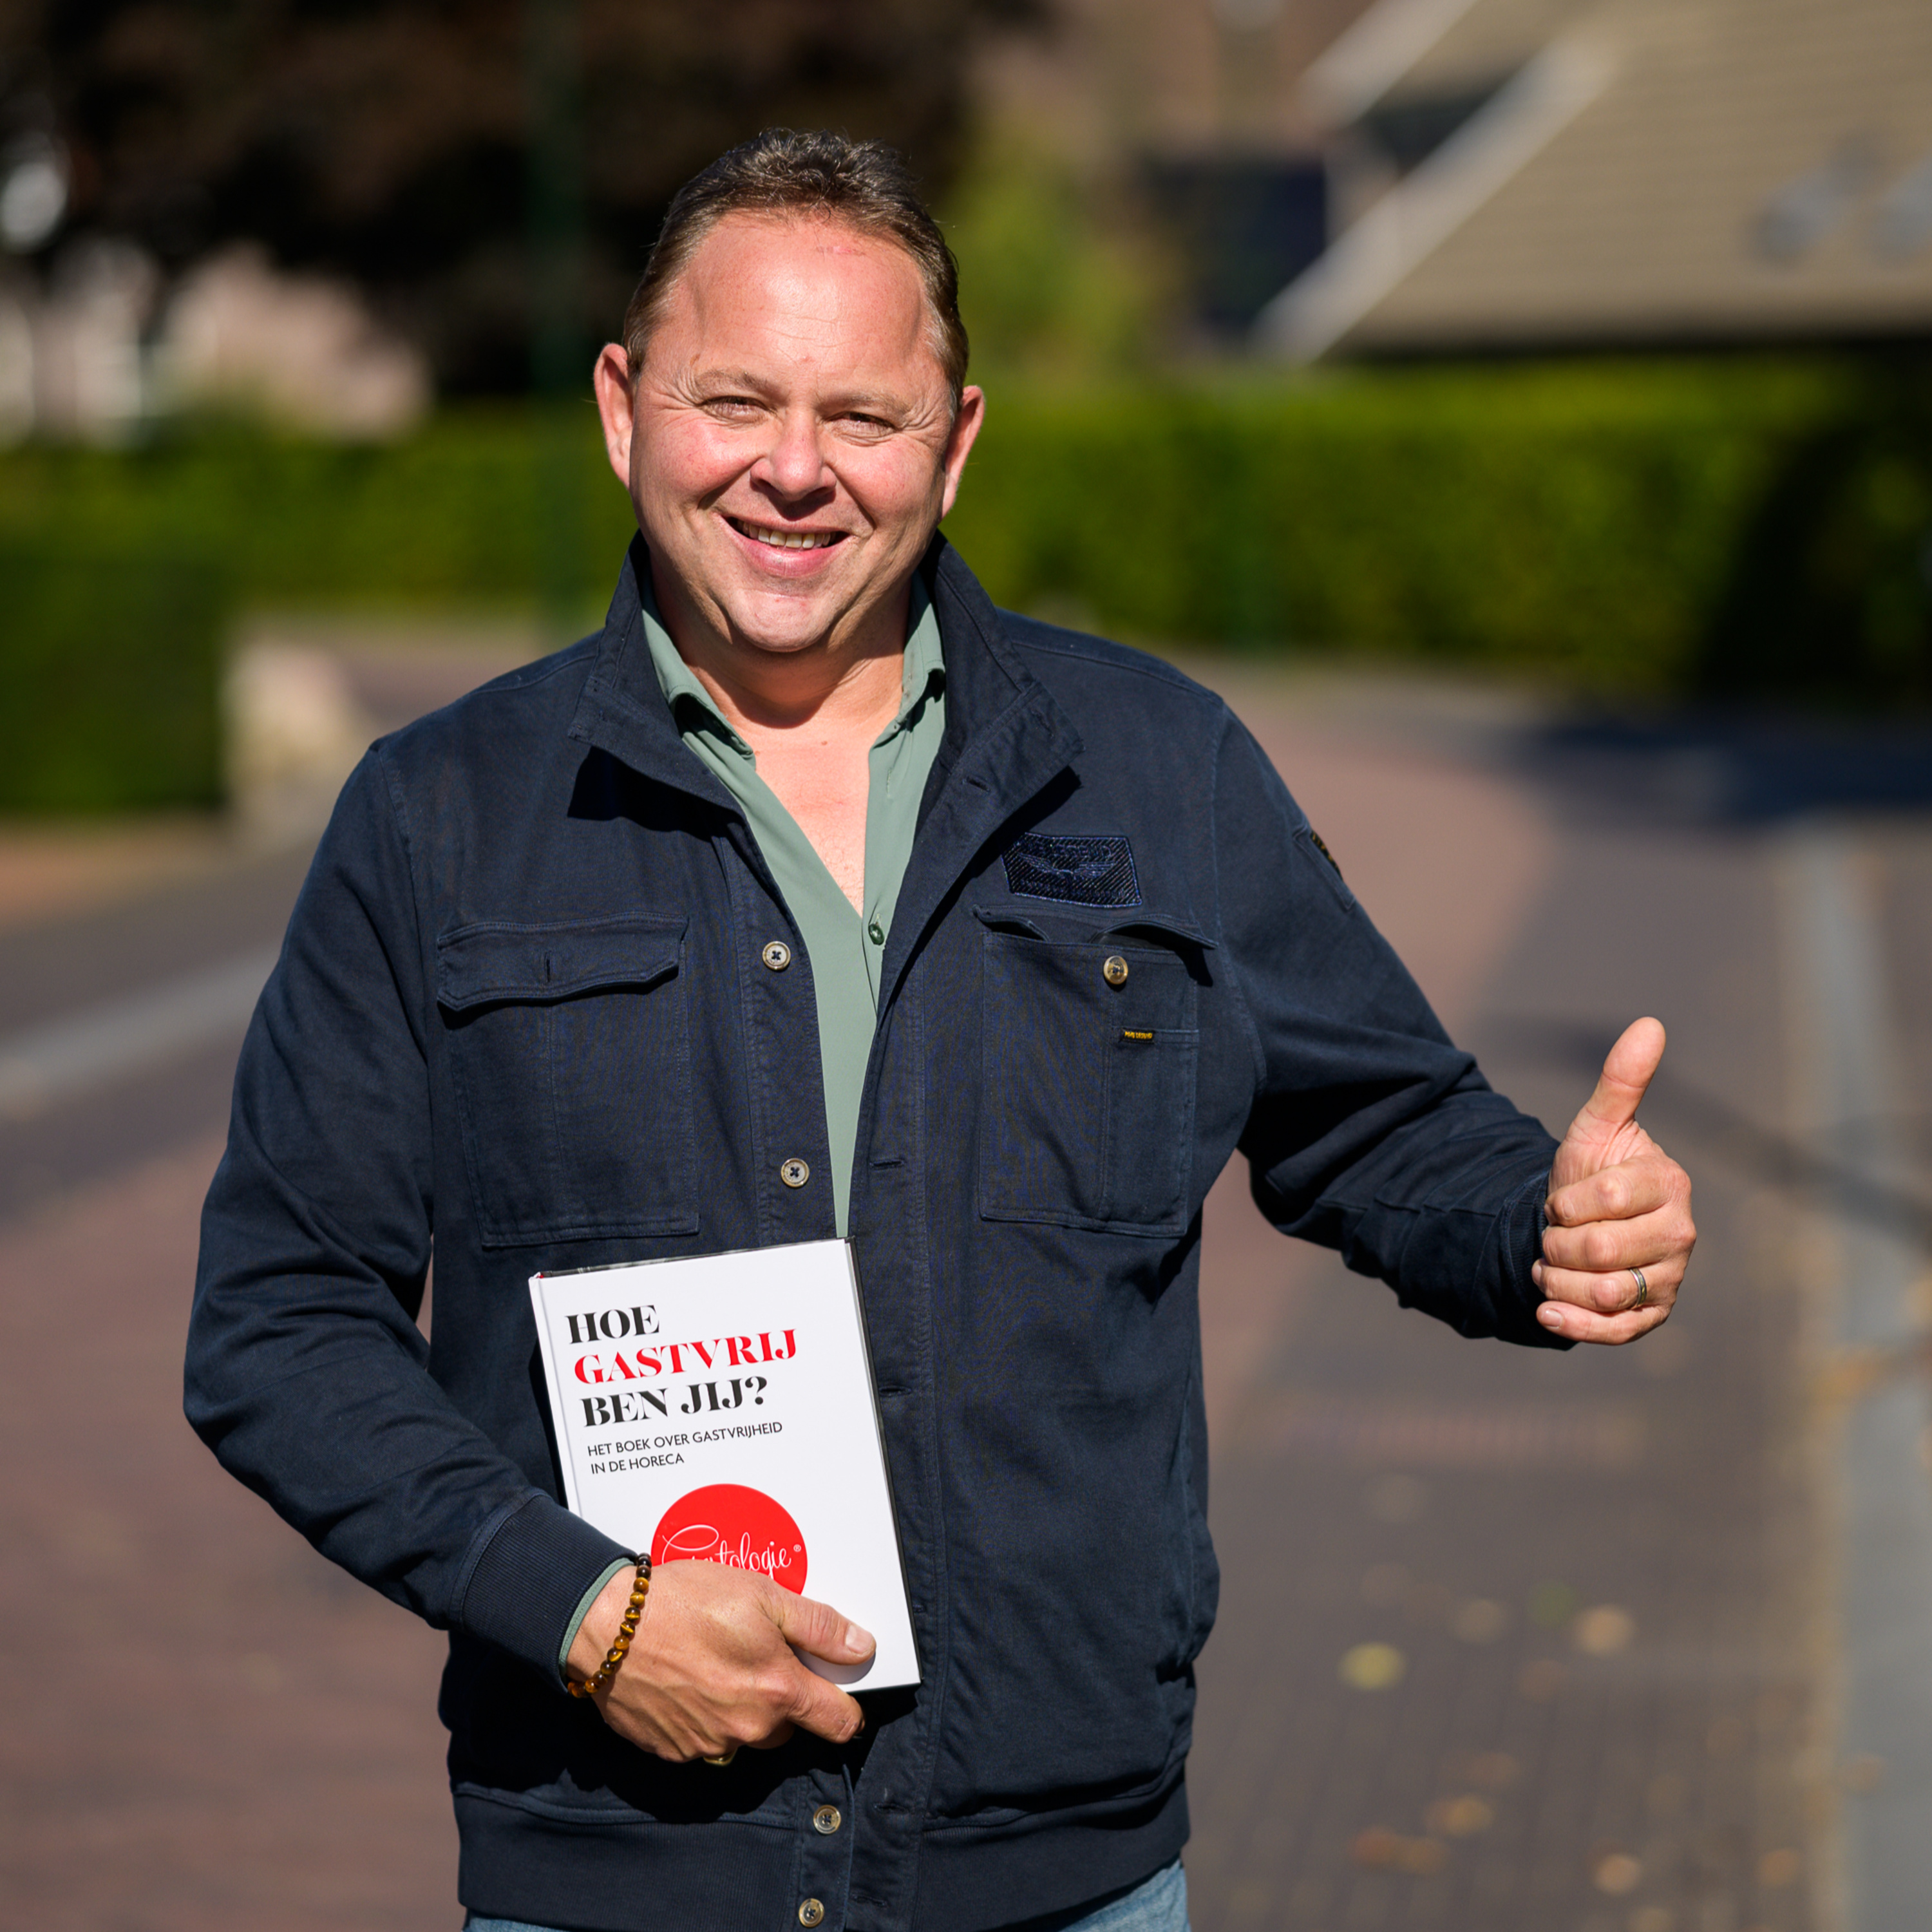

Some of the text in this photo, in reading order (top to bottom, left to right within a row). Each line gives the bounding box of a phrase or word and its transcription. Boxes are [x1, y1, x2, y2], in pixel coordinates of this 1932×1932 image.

[565, 1305, 659, 1344] HOE
[574, 1329, 797, 1385] GASTVRIJ
[580, 1376, 768, 1427] BEN JIJ?
[587, 1421, 783, 1457] HET BOEK OVER GASTVRIJHEID
[591, 1452, 685, 1475] IN DE HORECA
